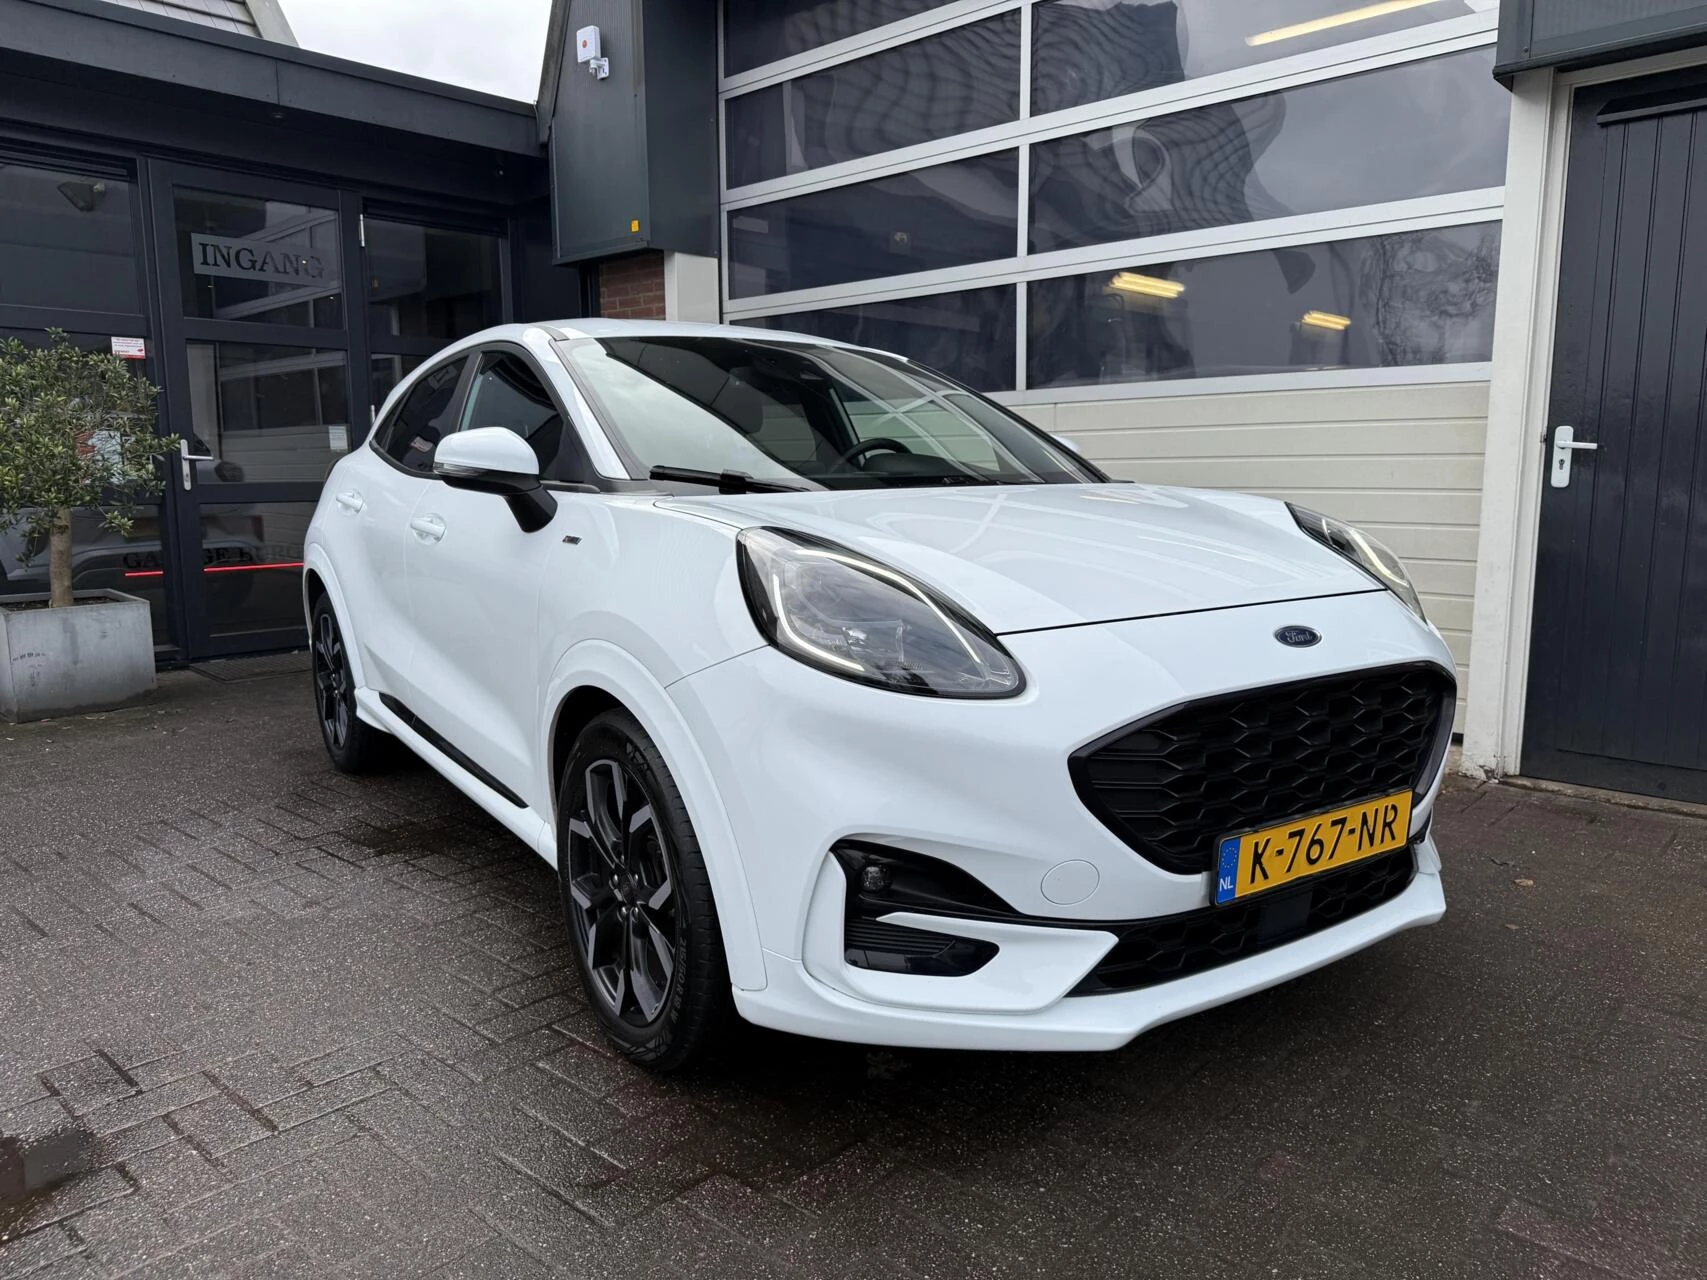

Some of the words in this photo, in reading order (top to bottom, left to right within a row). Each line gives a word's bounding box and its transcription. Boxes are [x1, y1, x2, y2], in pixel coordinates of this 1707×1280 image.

[199, 242, 325, 279] INGANG
[1284, 630, 1313, 643] Ford
[1250, 803, 1398, 884] K-767-NR
[1219, 876, 1234, 892] NL
